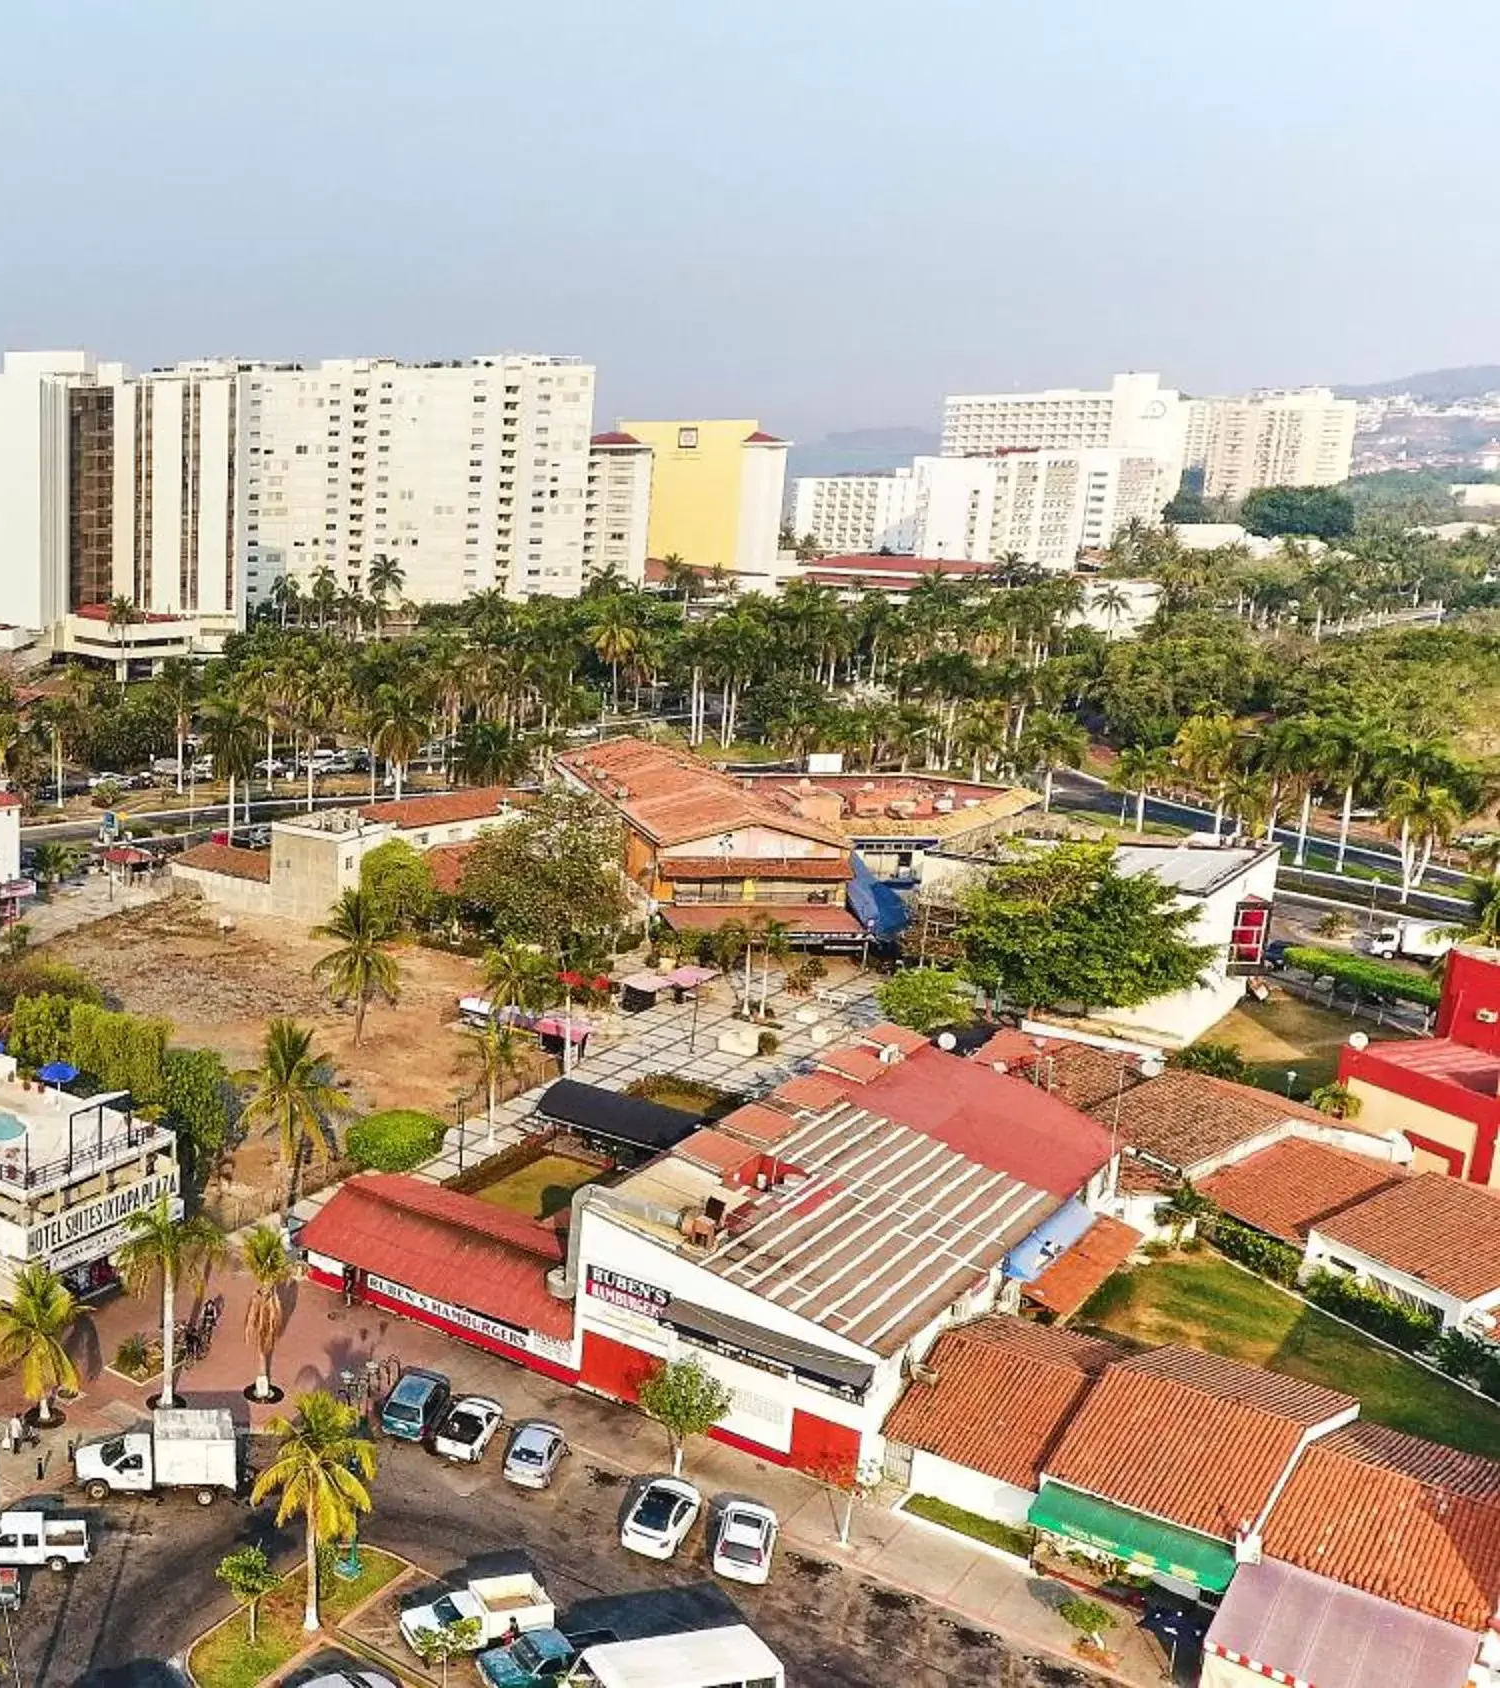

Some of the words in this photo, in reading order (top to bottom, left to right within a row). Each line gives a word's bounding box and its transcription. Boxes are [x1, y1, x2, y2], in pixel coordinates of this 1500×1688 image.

[27, 1222, 62, 1256] HOTEL
[65, 1203, 103, 1238] SUITES
[104, 1188, 140, 1222] IXTAPA
[141, 1172, 177, 1206] PLAZA
[591, 1266, 668, 1306] RUBEN'S
[431, 1301, 528, 1349] HAMBURGERS
